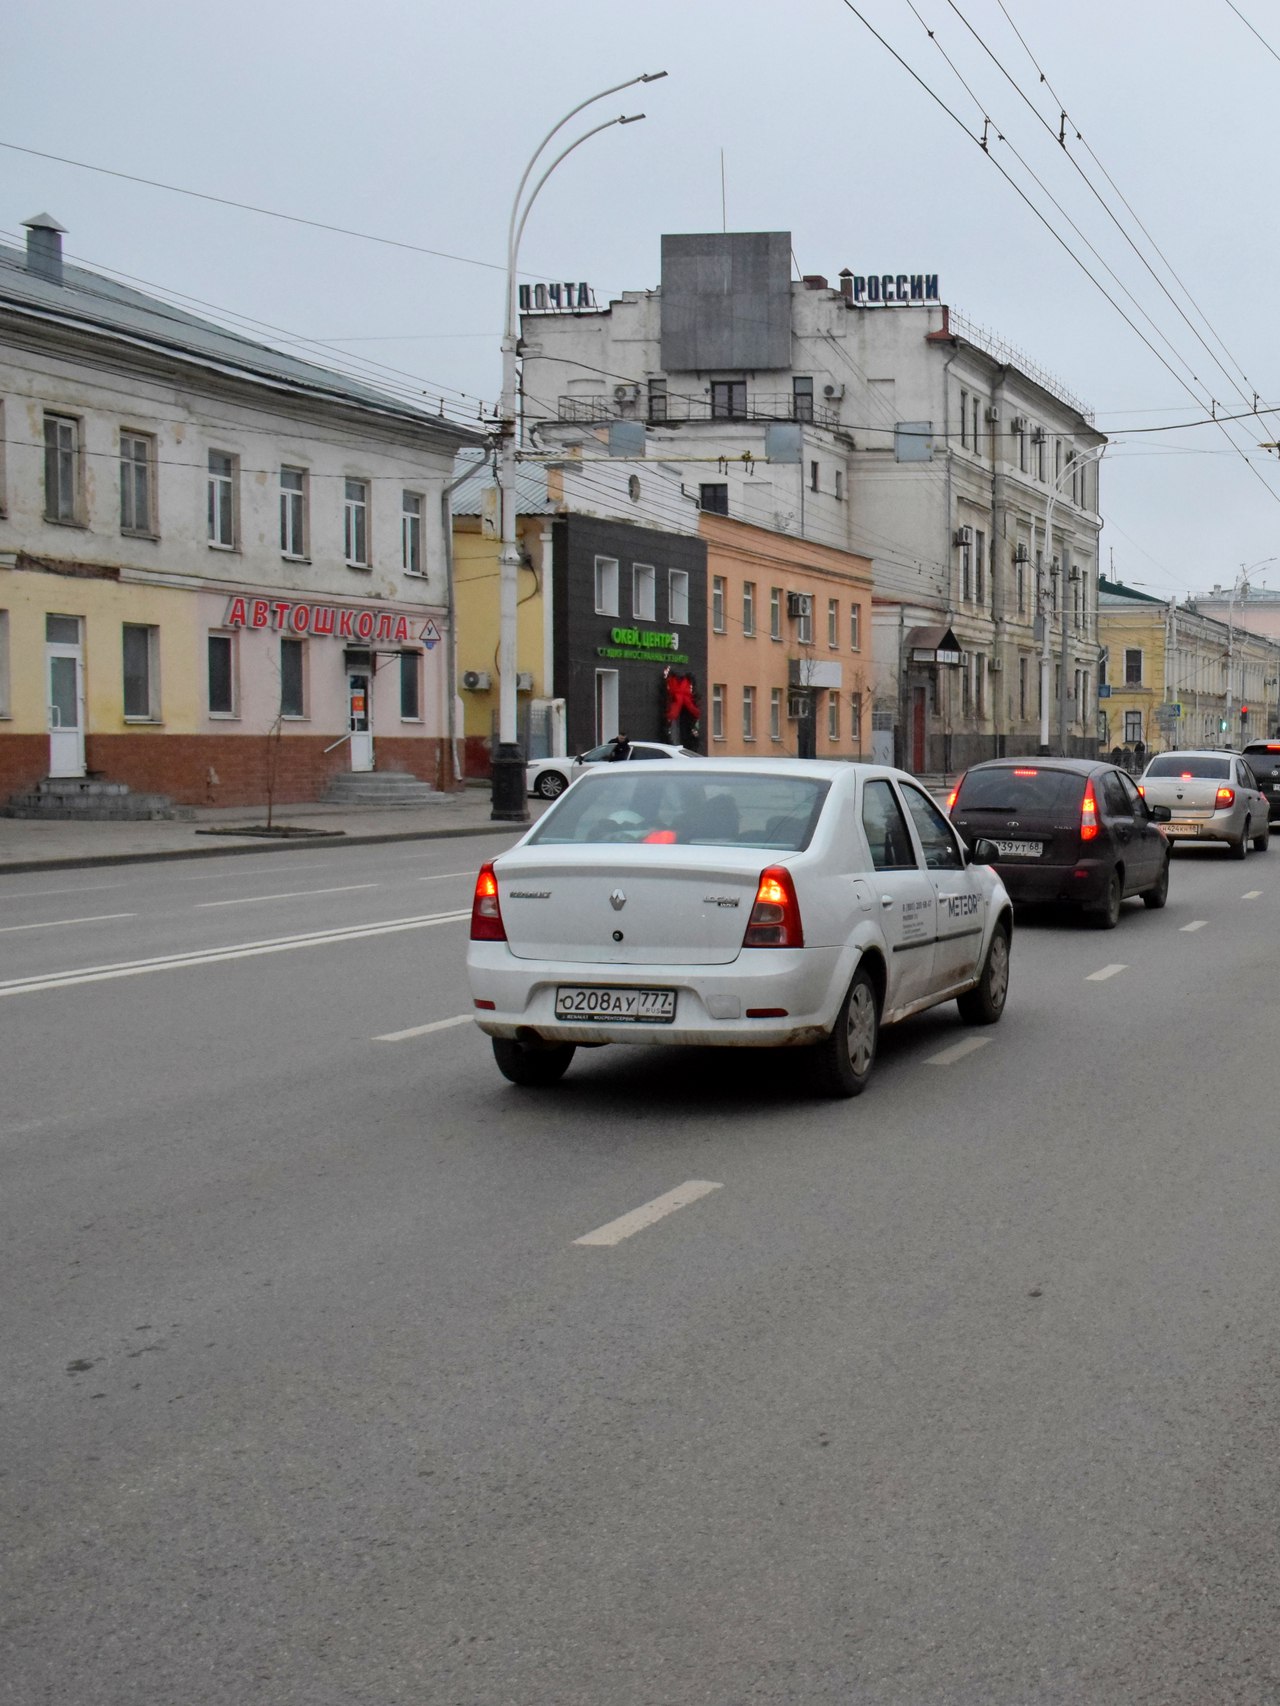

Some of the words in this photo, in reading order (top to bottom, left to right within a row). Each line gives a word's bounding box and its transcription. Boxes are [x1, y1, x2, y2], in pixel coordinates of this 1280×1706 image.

[518, 282, 591, 310] ПОЧТА
[853, 273, 939, 301] РОССИИ
[228, 597, 409, 642] АВТОШКОЛА
[996, 842, 1026, 852] 39УТ
[1029, 842, 1040, 851] 68
[948, 894, 978, 917] METEOR
[563, 992, 636, 1012] О208АУ
[641, 992, 669, 1008] 777
